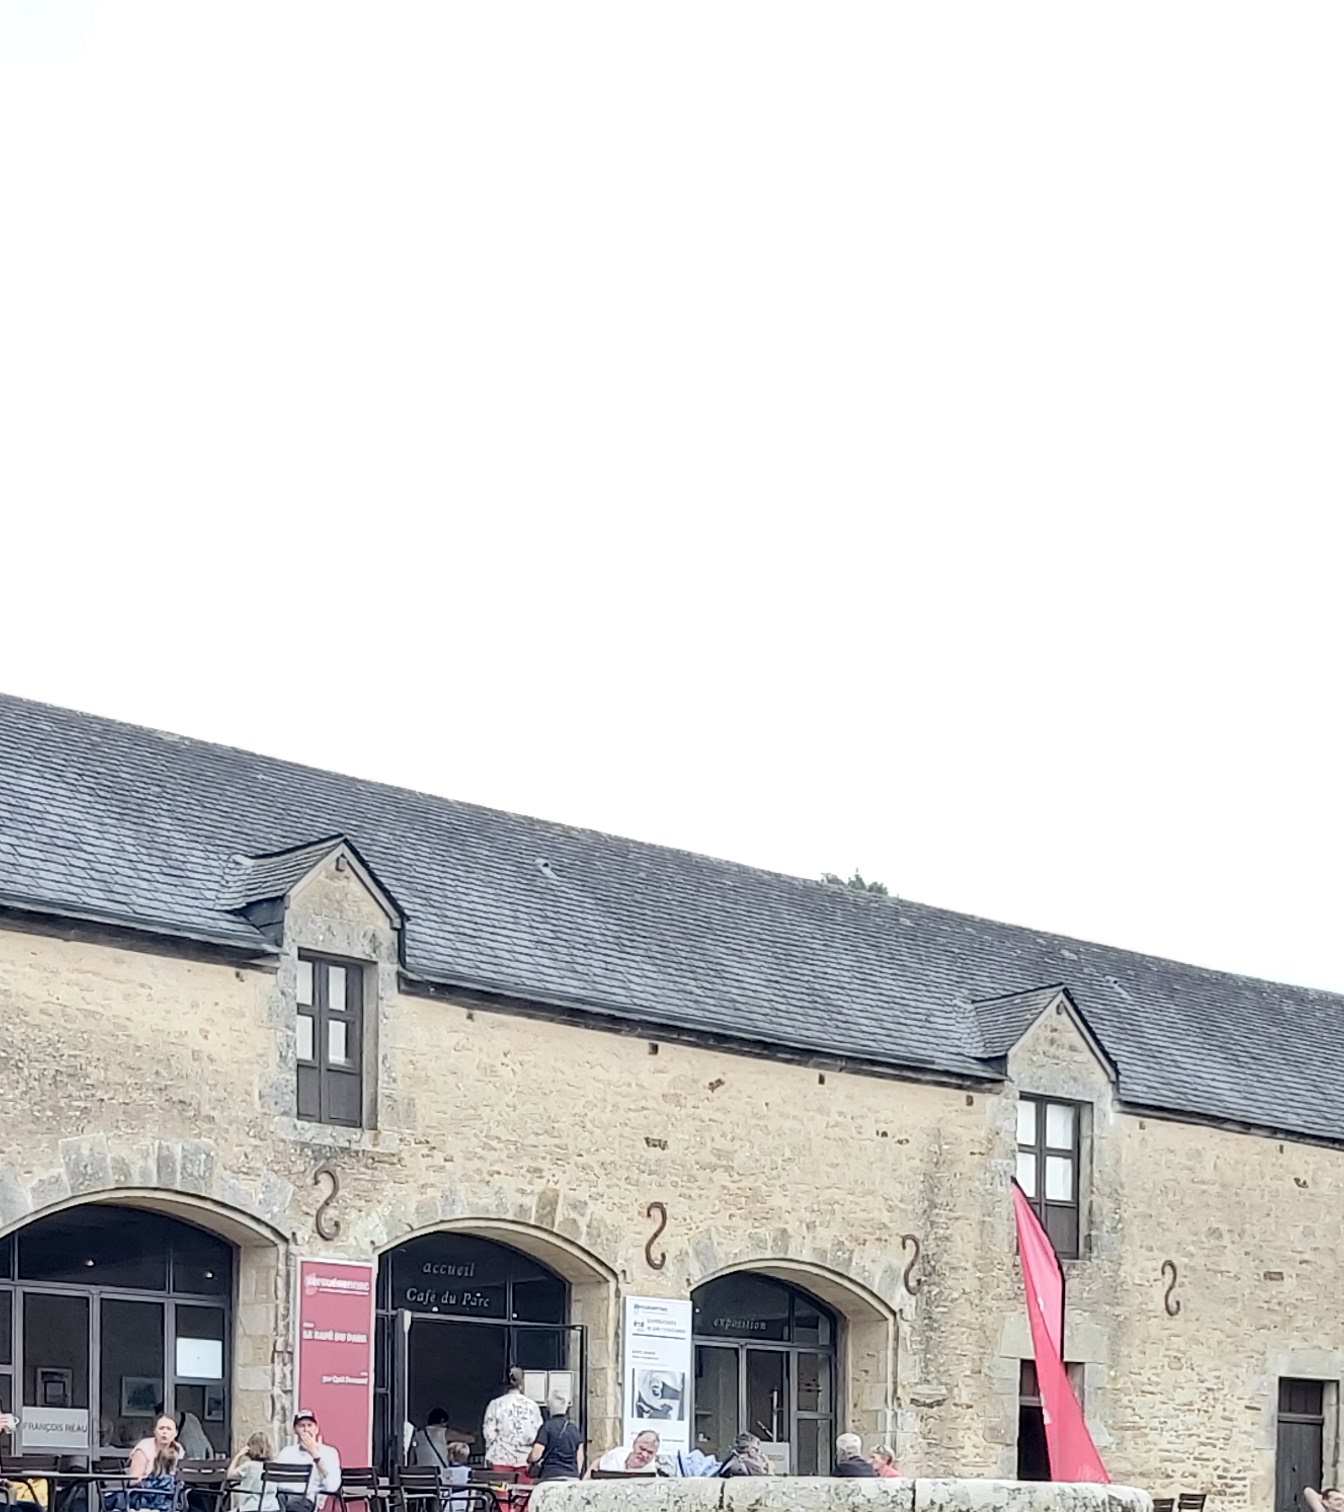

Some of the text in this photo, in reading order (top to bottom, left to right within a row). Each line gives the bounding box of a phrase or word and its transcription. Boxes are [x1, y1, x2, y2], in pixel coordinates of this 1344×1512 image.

[422, 1262, 475, 1277] accueil
[441, 1290, 457, 1304] du
[462, 1292, 490, 1308] Parc
[713, 1317, 767, 1330] exposition
